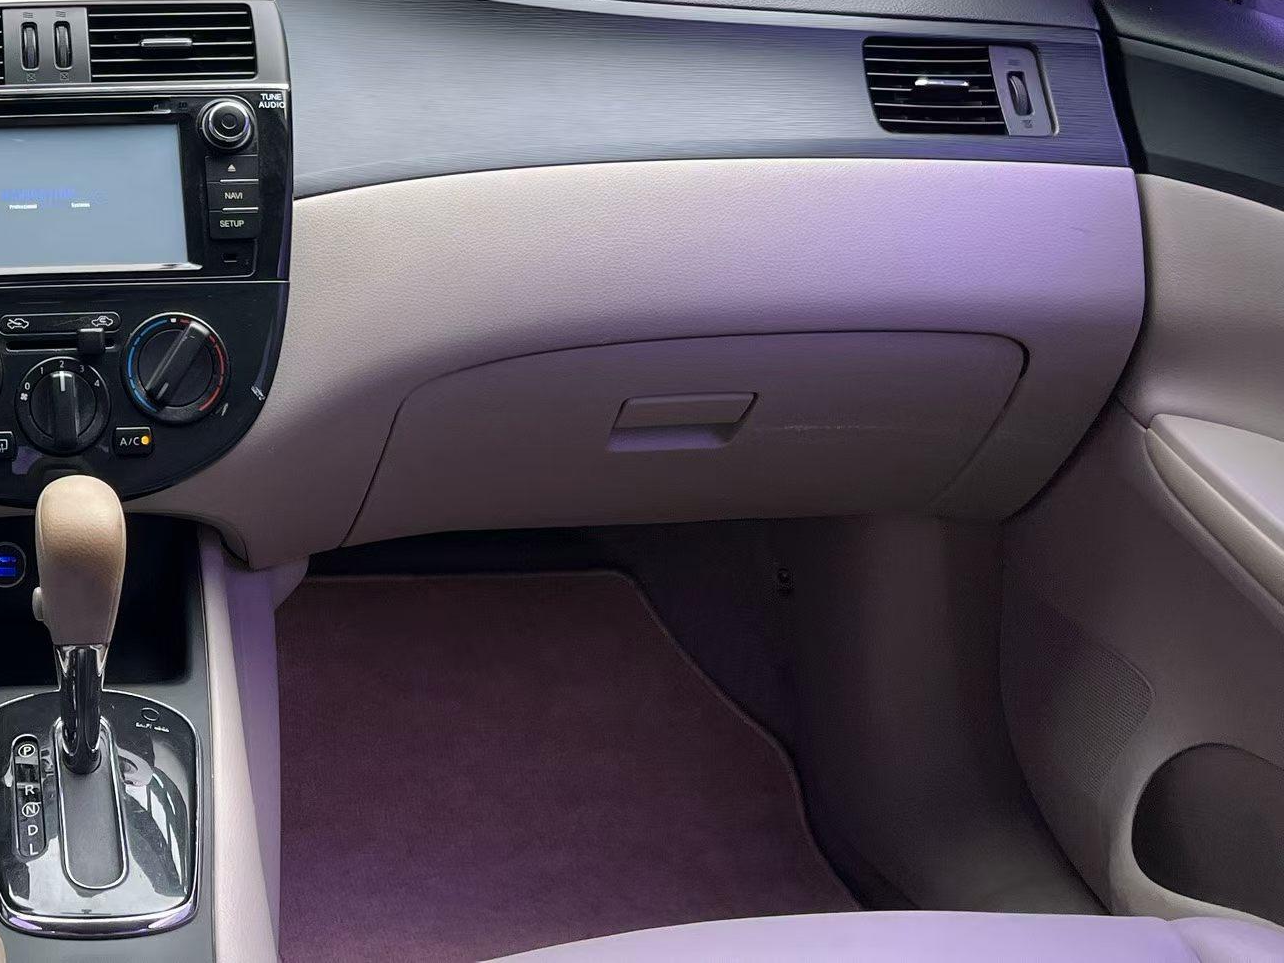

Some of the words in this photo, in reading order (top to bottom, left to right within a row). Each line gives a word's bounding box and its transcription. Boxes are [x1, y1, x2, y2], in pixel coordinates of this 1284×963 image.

[260, 93, 282, 101] TUNE
[258, 101, 285, 109] AUDIO
[224, 192, 243, 200] NAVI
[220, 219, 245, 227] SETUP
[60, 360, 65, 368] 2
[80, 365, 85, 373] 3
[24, 382, 31, 390] 0
[94, 379, 100, 387] 4
[120, 436, 140, 446] A/C
[25, 785, 35, 796] R
[28, 824, 39, 836] D
[29, 843, 39, 856] L
